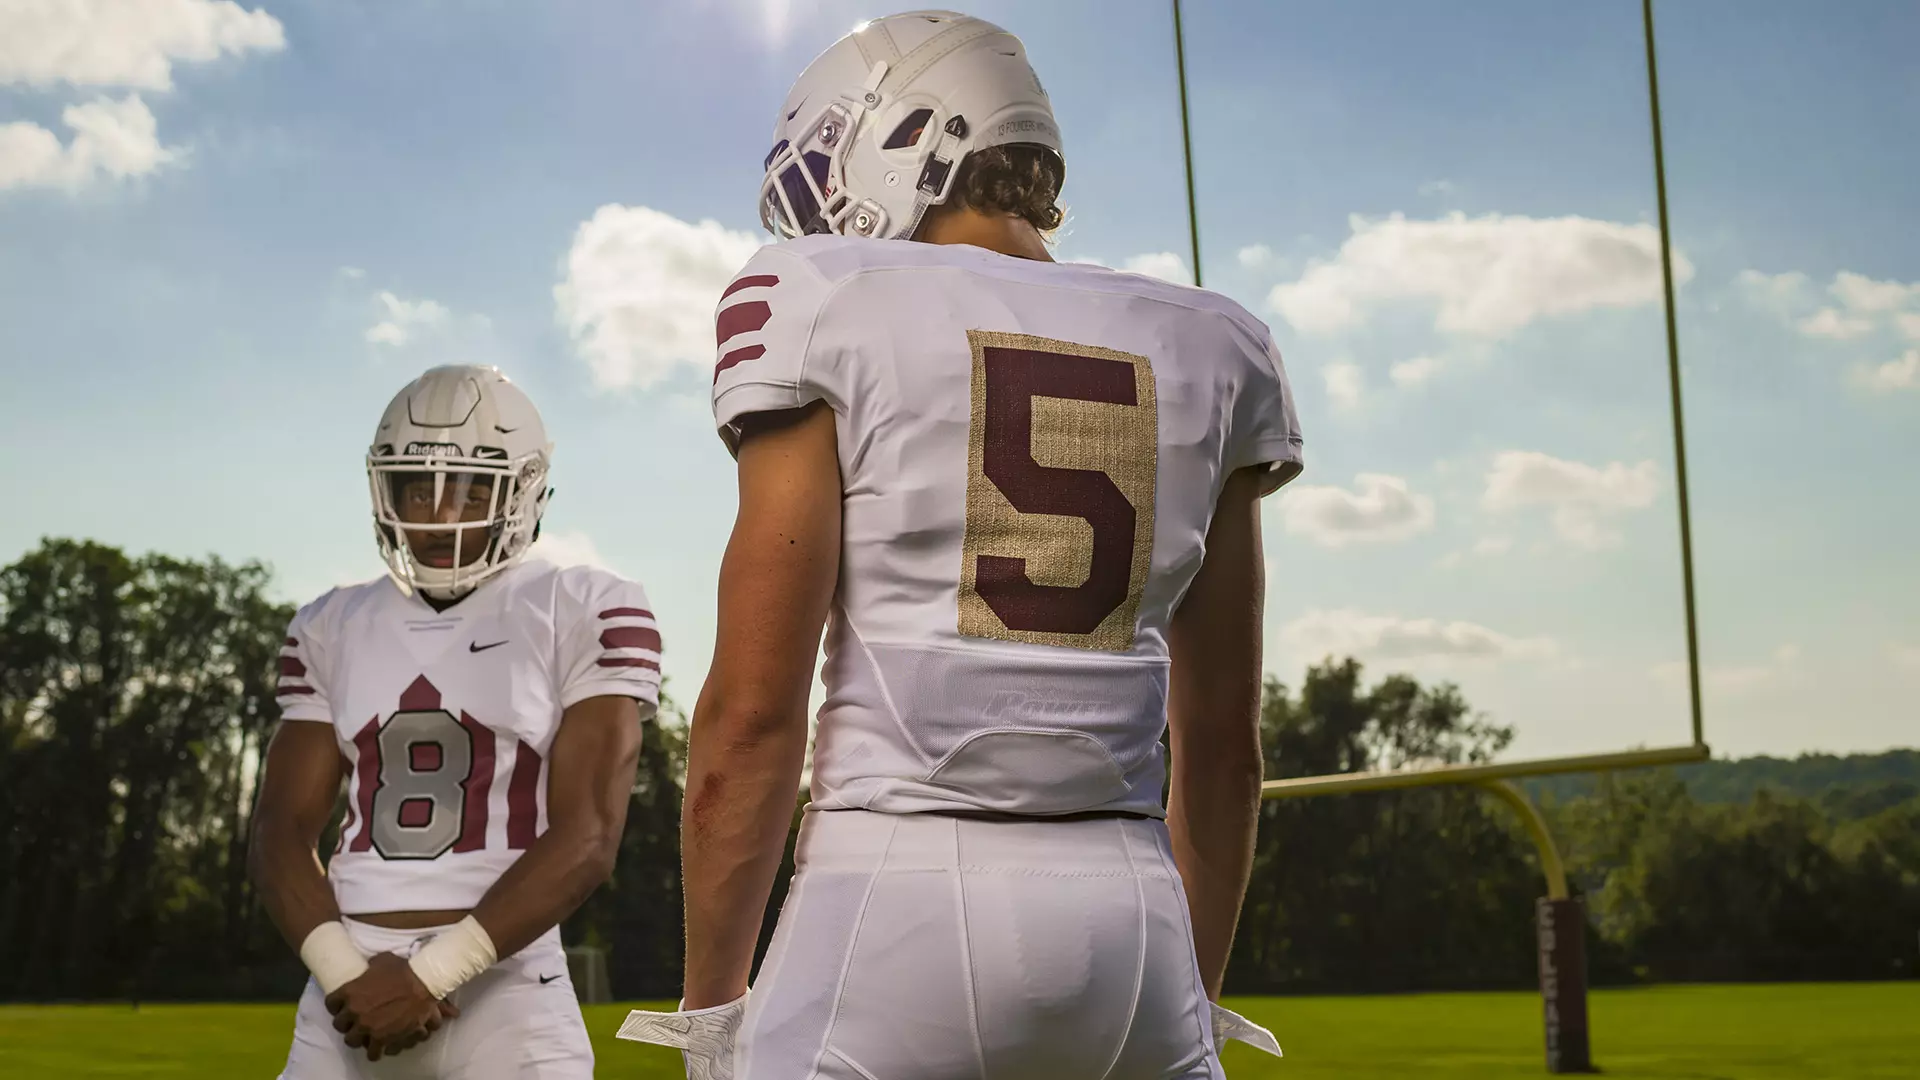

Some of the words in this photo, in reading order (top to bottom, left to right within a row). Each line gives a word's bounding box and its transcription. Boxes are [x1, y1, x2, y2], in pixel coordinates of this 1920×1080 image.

[408, 443, 456, 455] Riddll
[975, 346, 1138, 634] 5
[371, 709, 474, 860] 8
